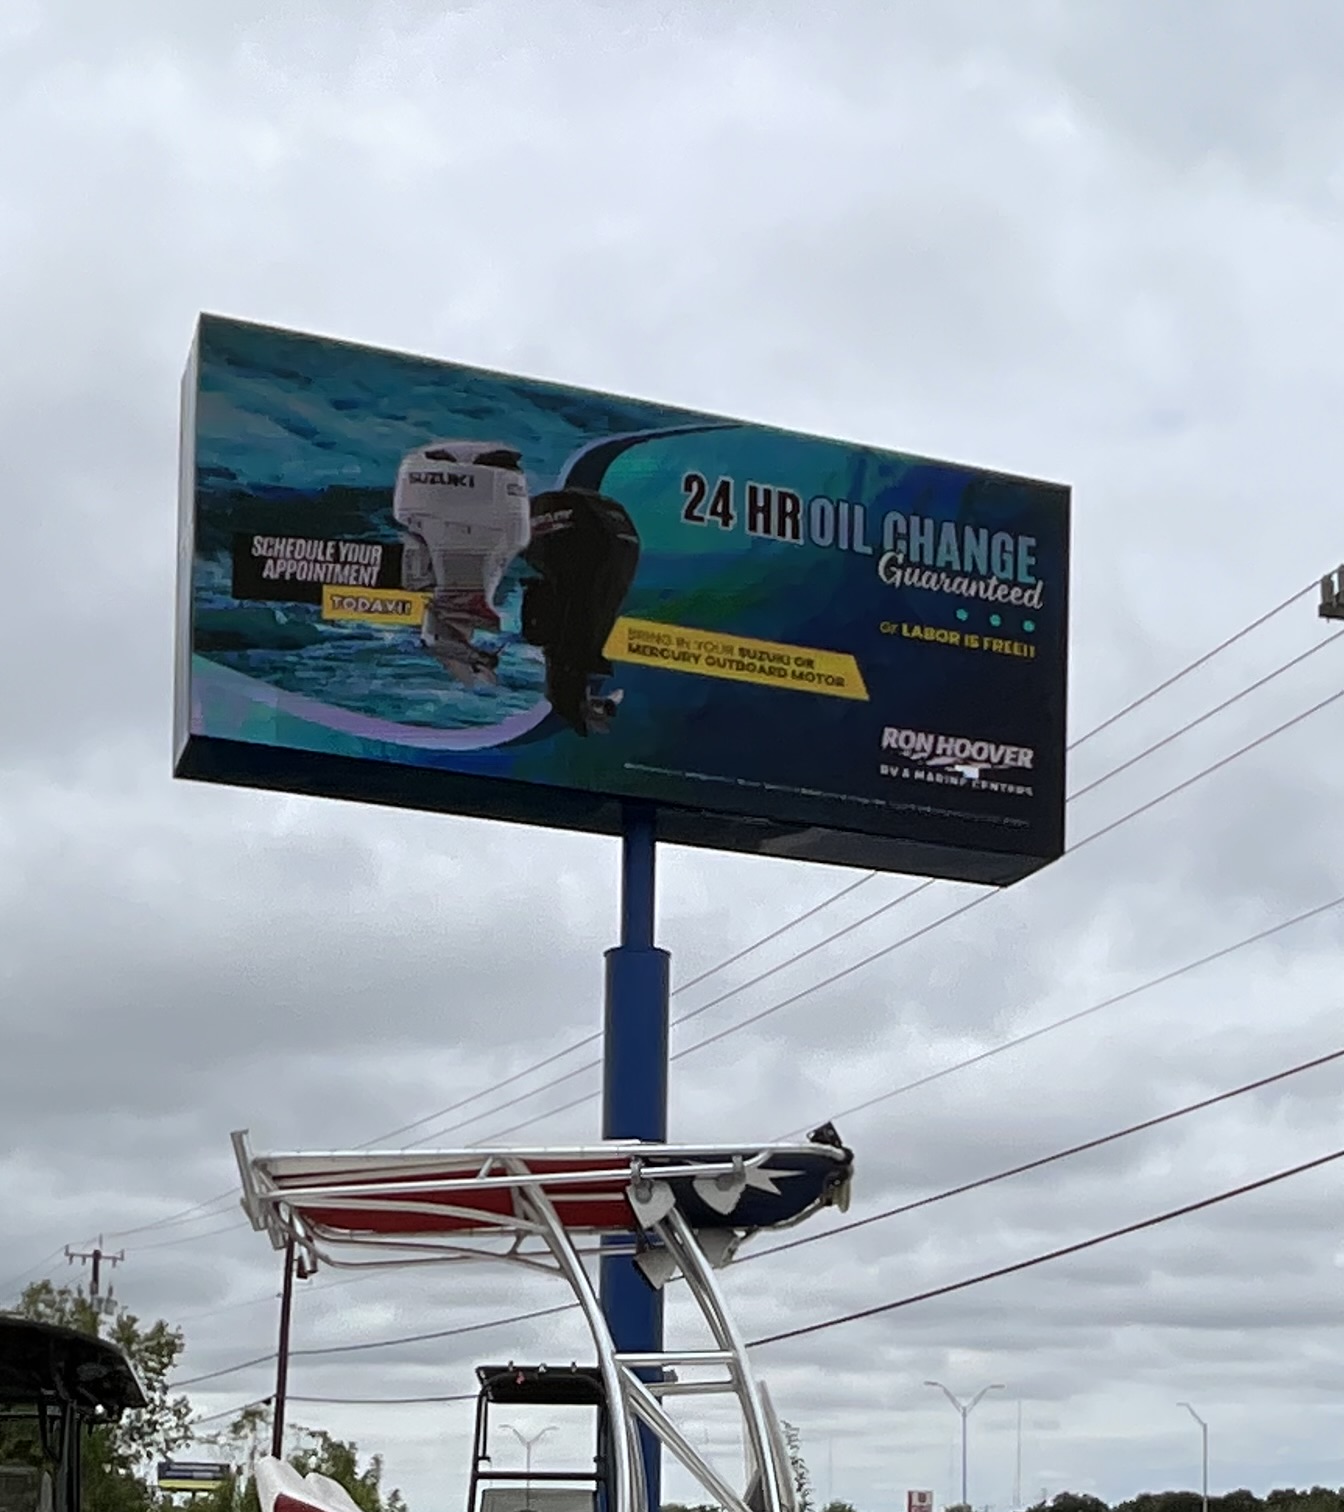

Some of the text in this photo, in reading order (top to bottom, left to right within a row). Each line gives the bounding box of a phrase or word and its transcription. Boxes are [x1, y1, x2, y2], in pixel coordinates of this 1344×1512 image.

[409, 471, 475, 488] SUZUKI
[681, 471, 1038, 585] 24 HR OIL CHANGE
[251, 535, 383, 565] SCHEDULE YOUR
[262, 558, 380, 587] APPOINTMENT
[877, 551, 1044, 610] Guaranteed
[901, 623, 961, 646] LABOR
[964, 634, 980, 649] IS
[627, 643, 846, 687] MERCURY OUTBOARD MOTOR
[738, 647, 792, 667] SUZUKI
[881, 726, 1035, 769] RON HOOVER
